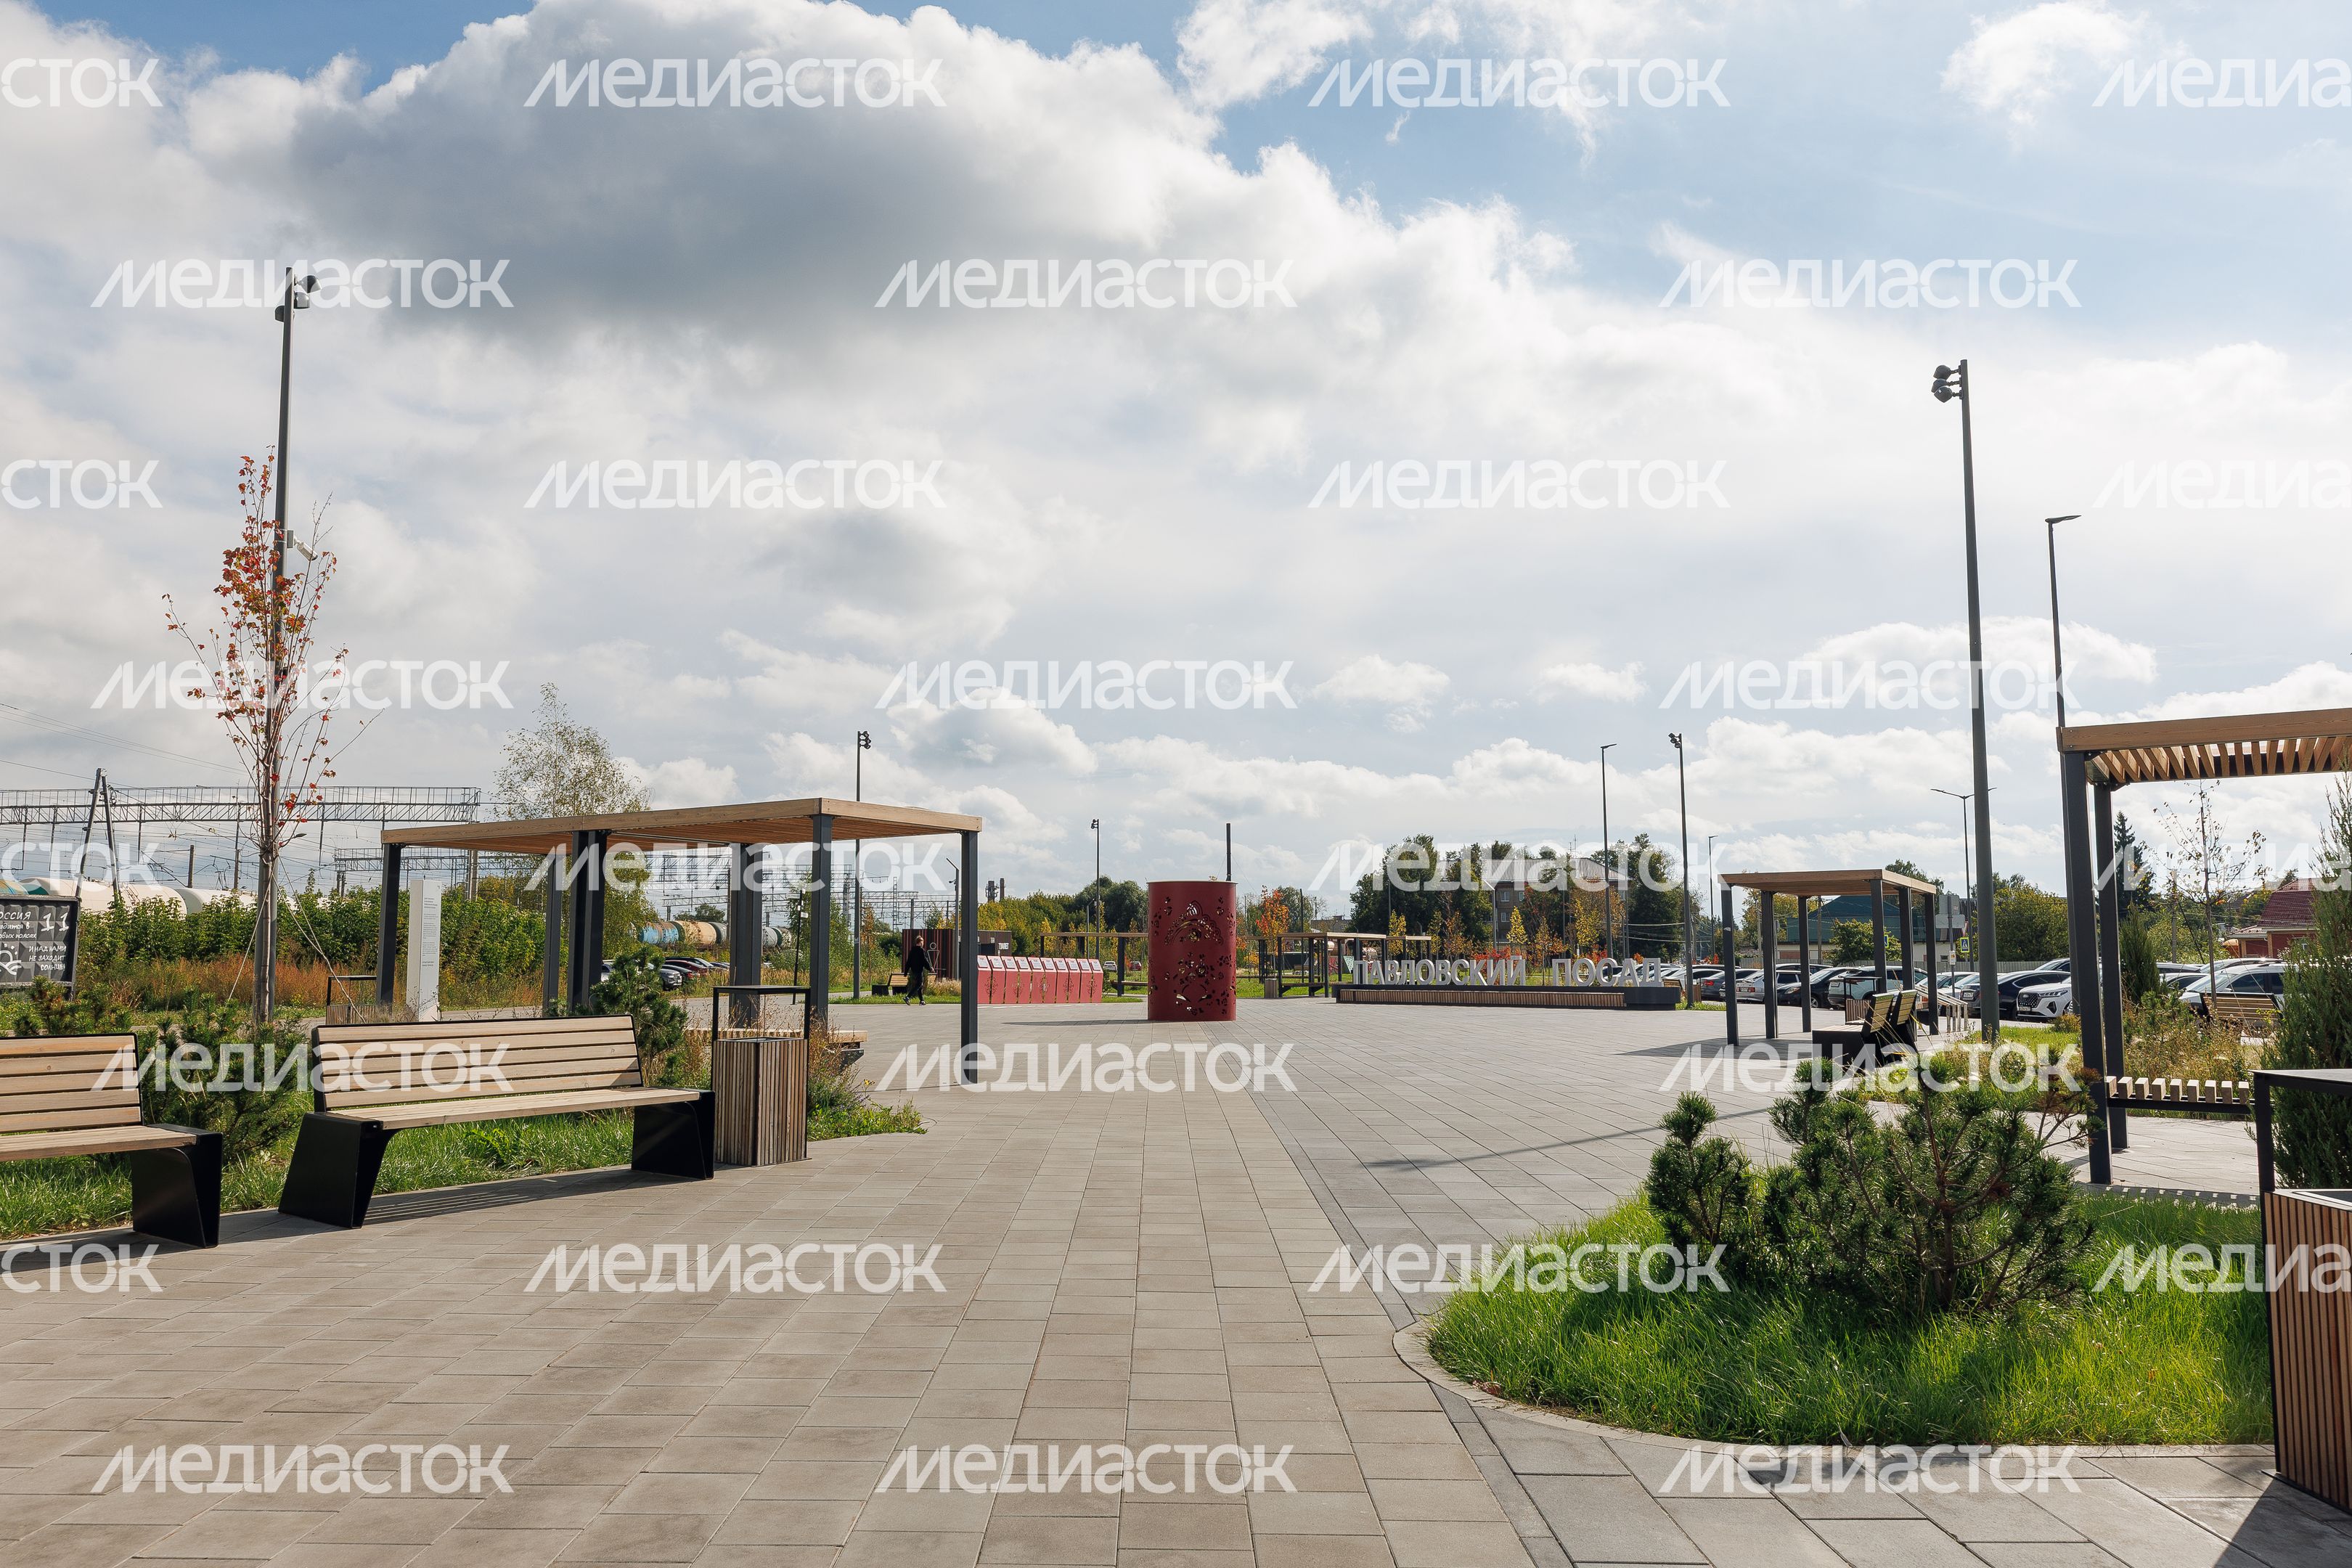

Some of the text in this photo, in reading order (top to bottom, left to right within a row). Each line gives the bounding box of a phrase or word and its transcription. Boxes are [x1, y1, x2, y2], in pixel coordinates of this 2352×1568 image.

[41, 912, 69, 931] 11
[1353, 955, 1664, 987] ПАВЛОВСКИЙ ПОСАД
